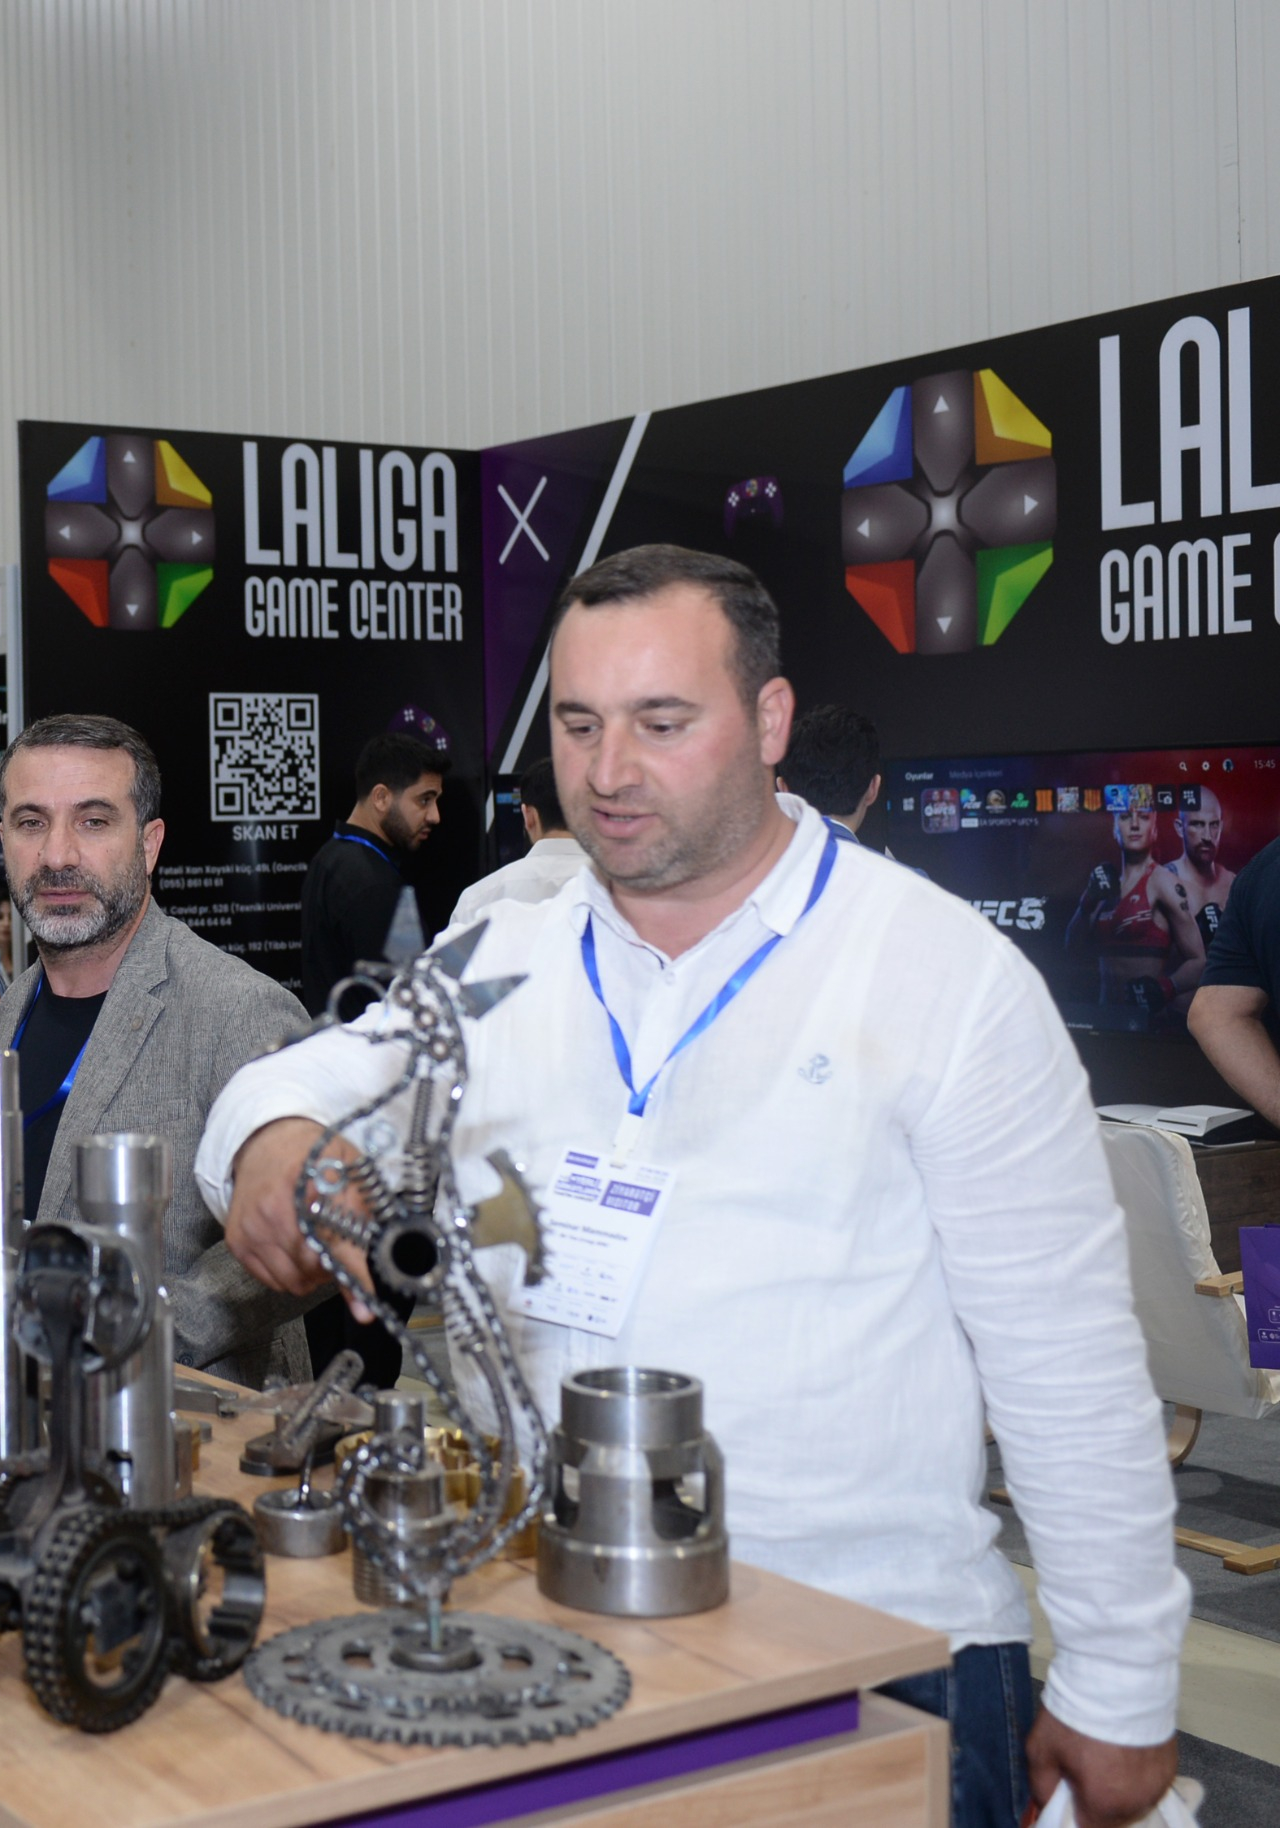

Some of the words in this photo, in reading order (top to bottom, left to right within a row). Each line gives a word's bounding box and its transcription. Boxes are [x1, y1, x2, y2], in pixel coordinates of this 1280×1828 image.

[243, 441, 458, 573] LALIGA
[244, 576, 339, 639] GAME
[349, 579, 463, 641] CENTER
[1100, 533, 1252, 644] GAME
[905, 772, 934, 782] Oyunlar
[1253, 760, 1276, 769] 15:45
[232, 824, 277, 841] SKAN
[281, 824, 299, 840] ET
